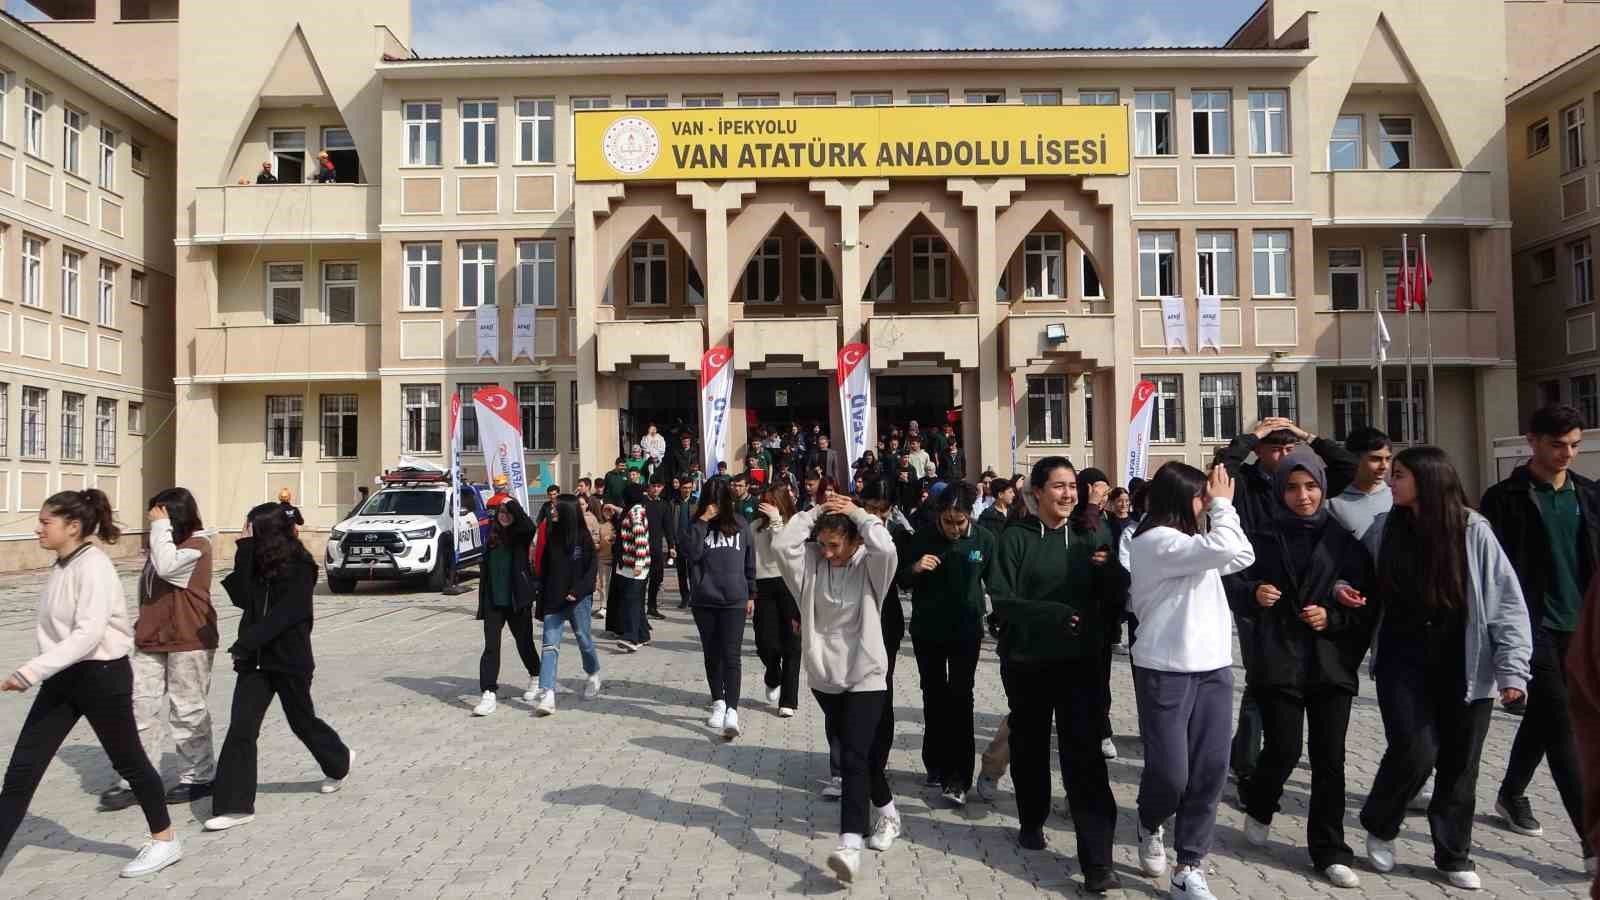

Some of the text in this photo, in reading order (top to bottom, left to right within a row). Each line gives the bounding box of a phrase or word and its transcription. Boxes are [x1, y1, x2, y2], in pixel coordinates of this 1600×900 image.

[671, 121, 704, 136] VAN
[718, 117, 797, 135] İPEKYOLU
[671, 143, 728, 169] VAN
[737, 136, 867, 168] ATATÜRK
[875, 140, 1010, 167] ANADOLU
[1020, 133, 1107, 165] LİSESİ
[851, 394, 867, 445] AFAD
